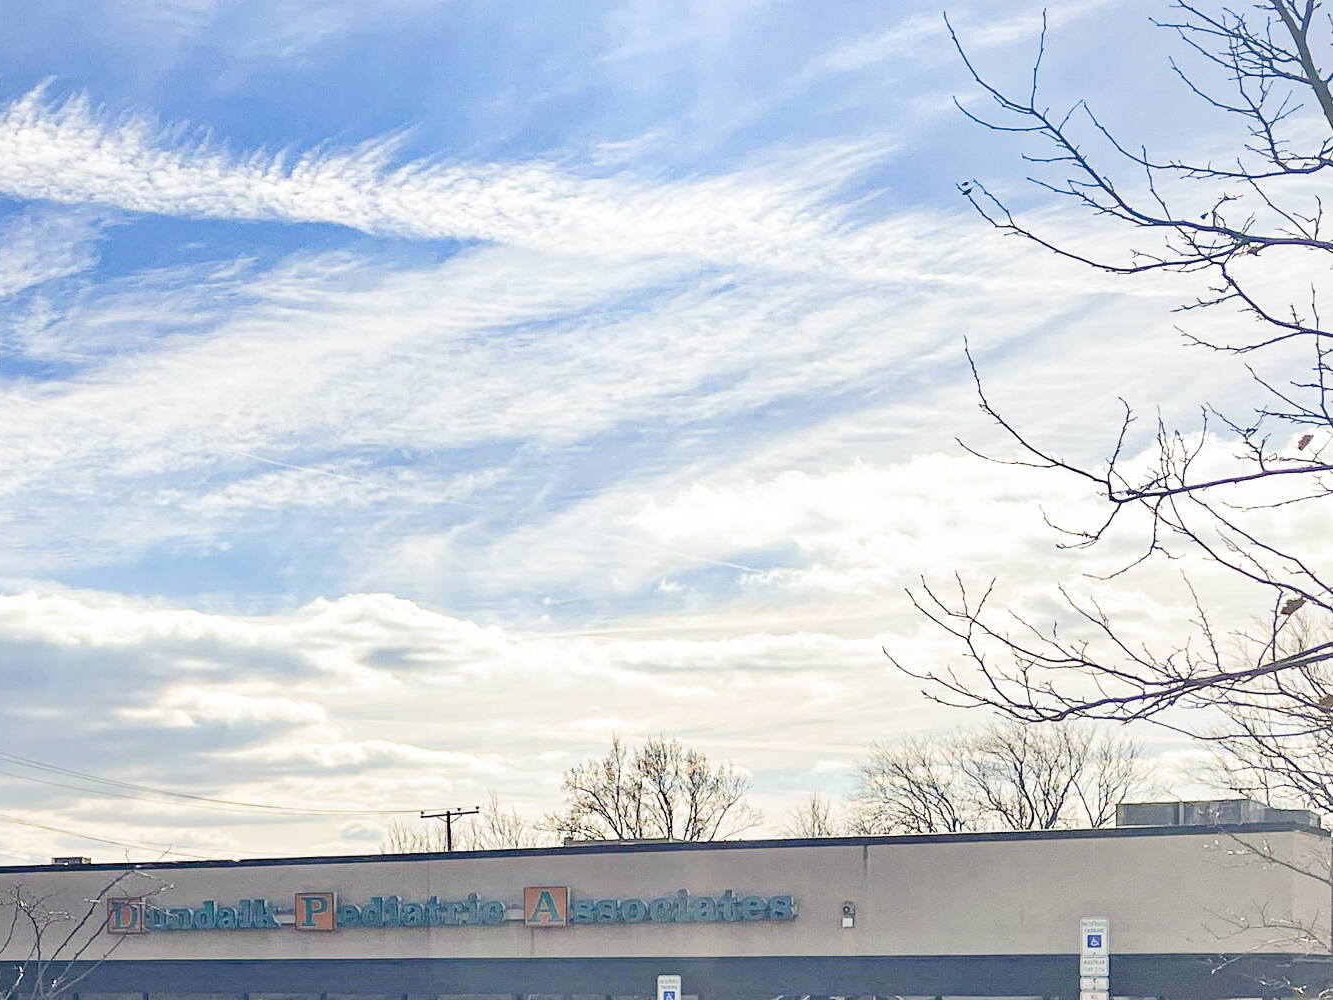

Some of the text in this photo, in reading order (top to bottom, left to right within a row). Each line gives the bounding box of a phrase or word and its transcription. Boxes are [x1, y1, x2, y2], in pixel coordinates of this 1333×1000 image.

[111, 888, 795, 931] Dundalk Pediatric Associates
